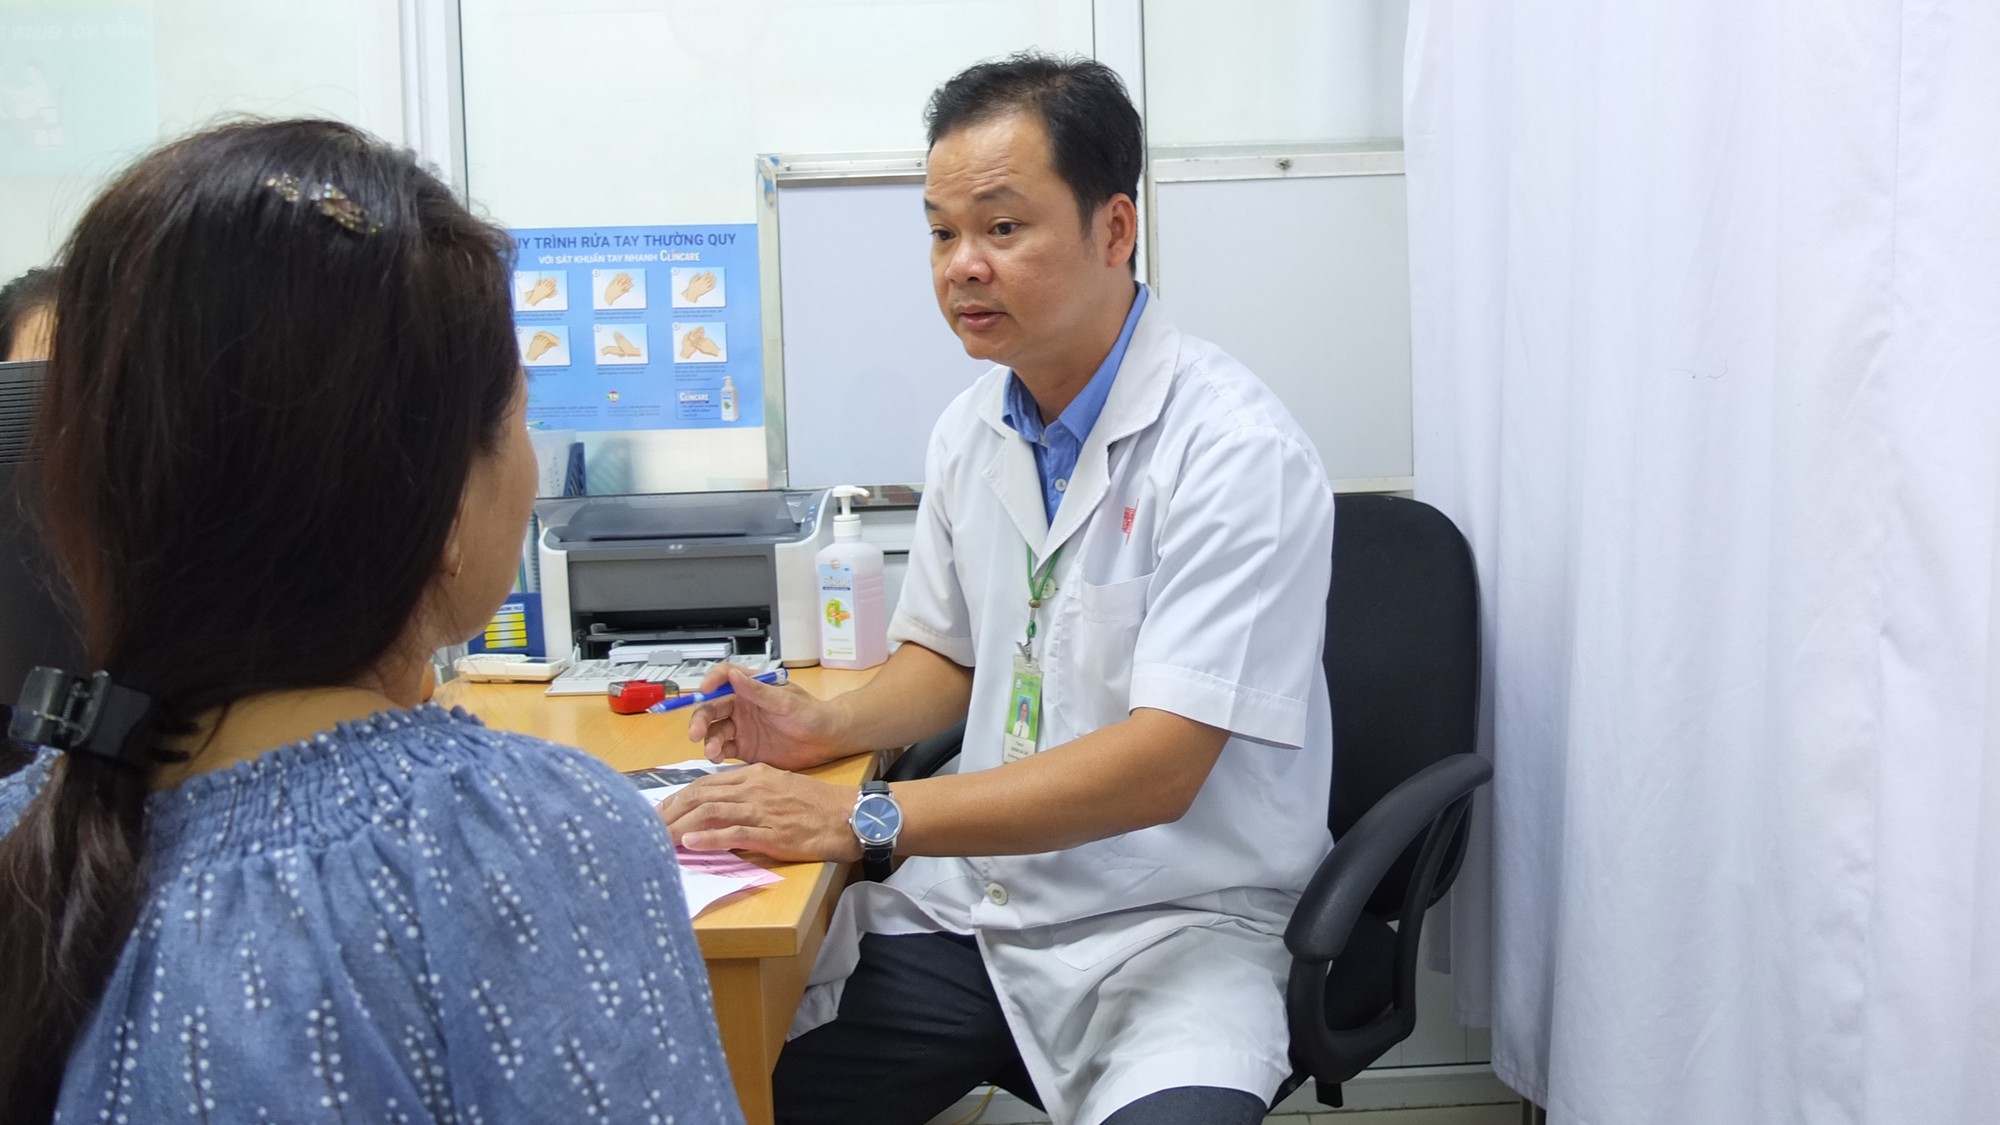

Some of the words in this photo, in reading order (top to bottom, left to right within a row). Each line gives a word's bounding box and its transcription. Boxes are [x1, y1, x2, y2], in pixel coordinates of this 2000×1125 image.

[534, 234, 577, 249] TRÌNH
[581, 232, 611, 248] RỬA
[613, 235, 639, 247] TAY
[643, 232, 704, 246] THƯỜNG
[707, 233, 737, 246] QUY
[538, 253, 554, 264] VỚI
[555, 253, 574, 264] SÁT
[606, 254, 623, 263] TAY
[624, 253, 658, 263] NHANH
